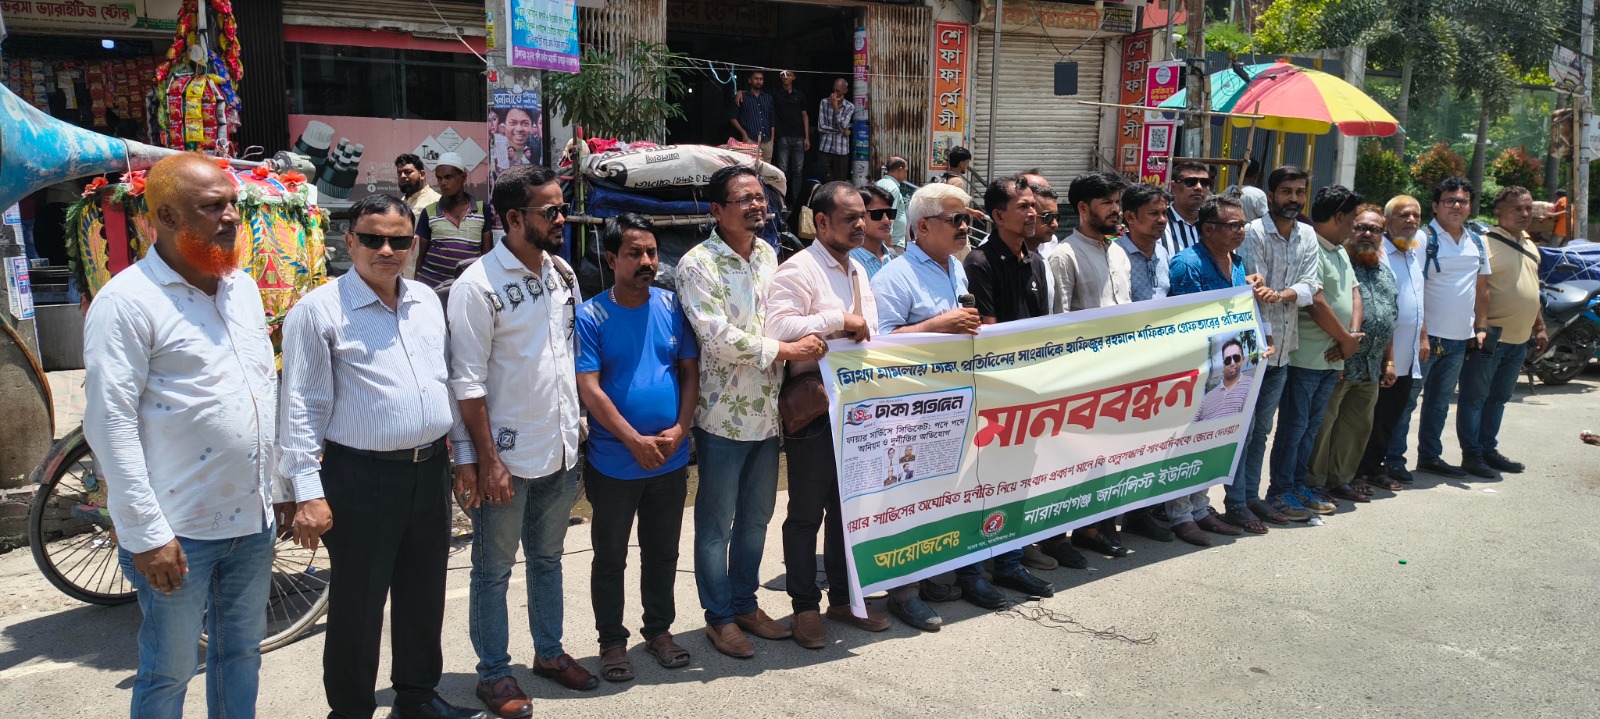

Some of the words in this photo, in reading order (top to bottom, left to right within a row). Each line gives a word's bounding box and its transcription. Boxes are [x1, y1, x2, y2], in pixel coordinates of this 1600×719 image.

[36, 0, 97, 18] ভ্যারাইটিজ
[836, 367, 874, 387] মিথ্যা
[877, 363, 928, 380] মামলায়
[931, 360, 959, 374] ঢাকা
[960, 351, 1016, 372] প্রতিদিনের
[1018, 341, 1064, 363] সাংবাদিক
[1105, 331, 1136, 348] রহমান
[1137, 324, 1176, 342] শফিককে
[1177, 316, 1220, 335] গ্রেফতারের
[1221, 310, 1254, 325] প্রতিবাদে
[875, 402, 910, 419] ঢাকা
[911, 396, 964, 416] প্রতিদিন
[973, 368, 1199, 450] মানববন্ধন
[873, 502, 915, 525] সার্ভিসের
[917, 491, 962, 512] অঘোষিত
[996, 481, 1018, 496] নিয়ে
[1019, 473, 1049, 489] সংবাদ
[1049, 464, 1075, 482] প্রকাশ
[1076, 458, 1094, 474] মানে
[1094, 454, 1106, 469] কি
[1024, 491, 1093, 525] নারায়ণগঞ্জ
[1095, 471, 1157, 503] জার্নালিস্ট
[1157, 459, 1204, 486] ইউনিটি
[873, 530, 961, 569] আয়োজনেঃ
